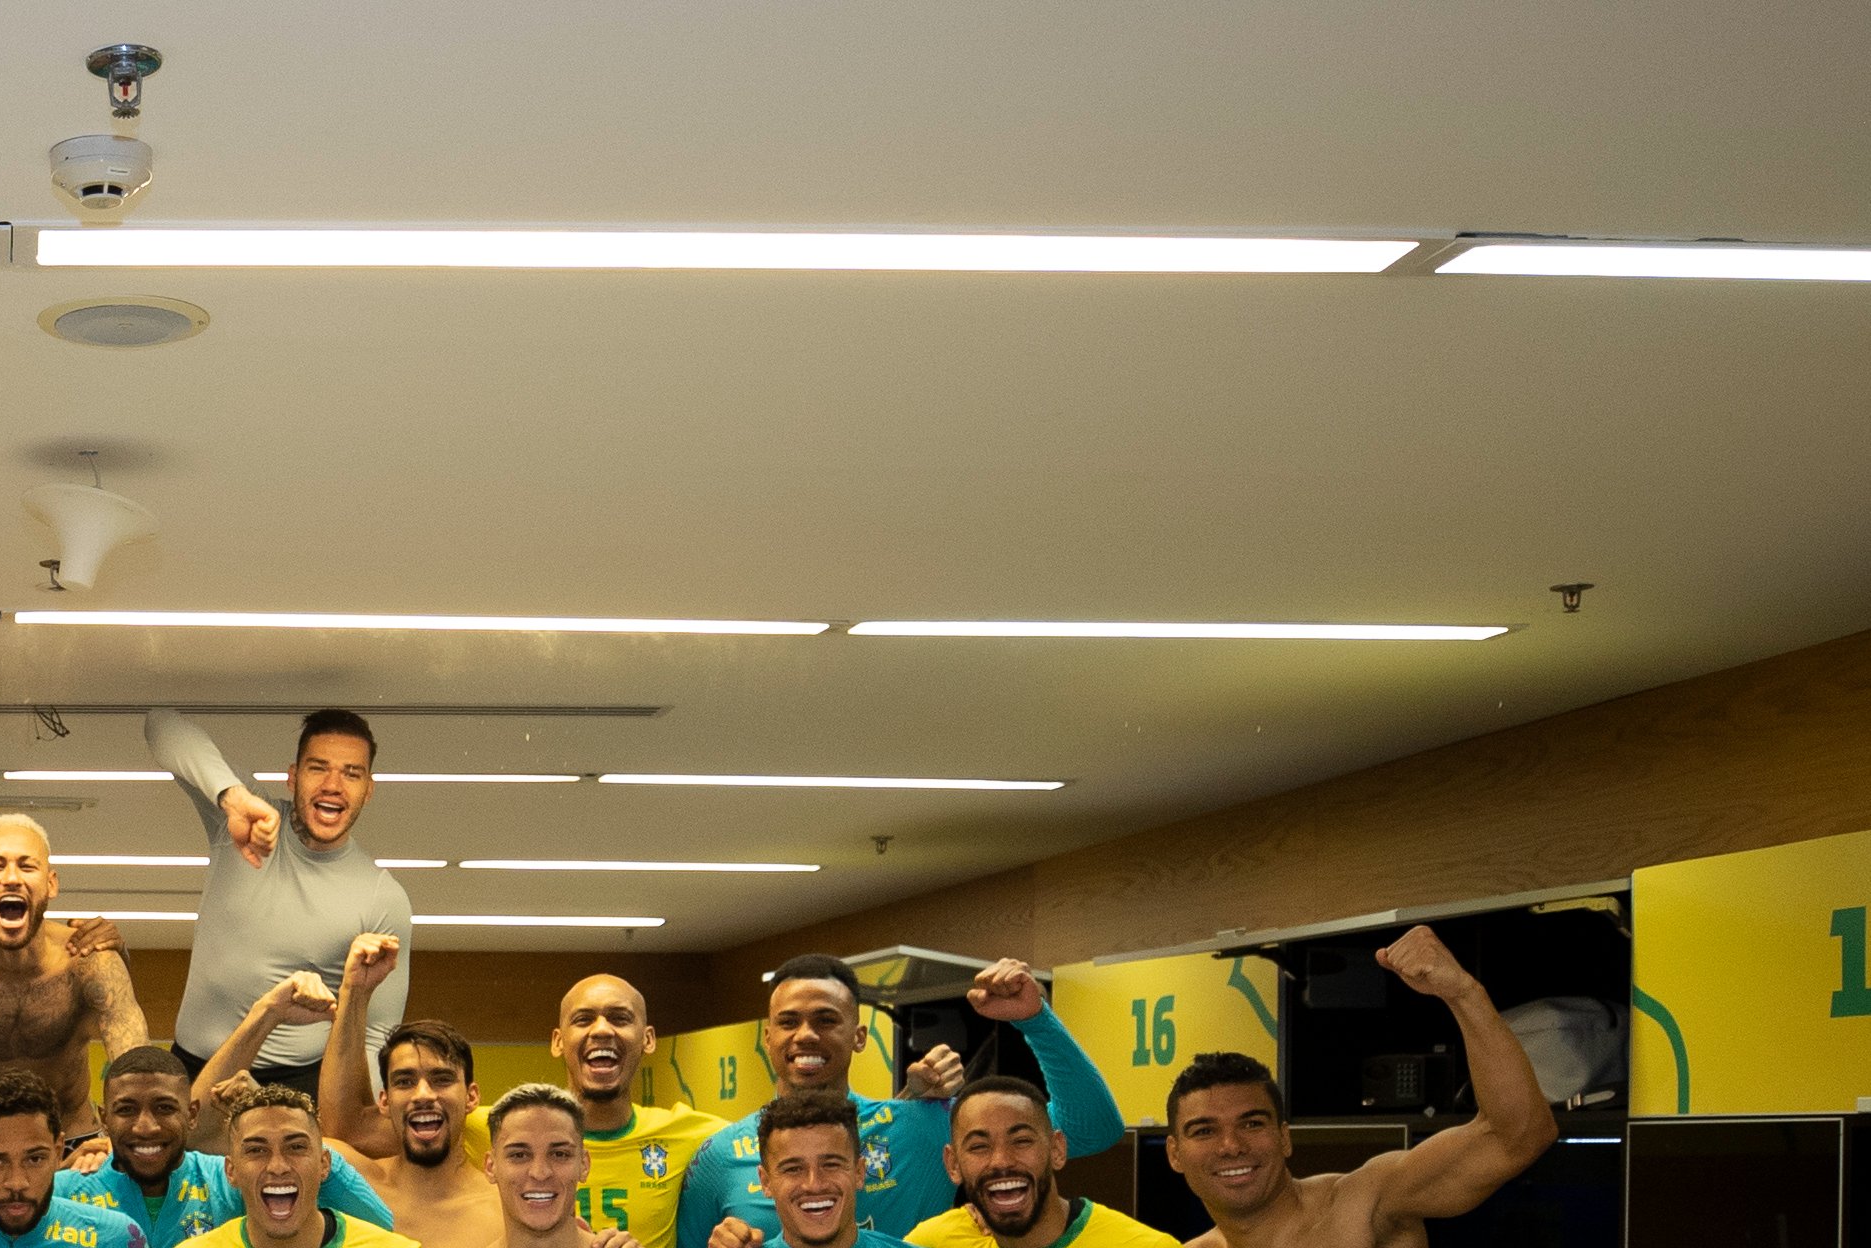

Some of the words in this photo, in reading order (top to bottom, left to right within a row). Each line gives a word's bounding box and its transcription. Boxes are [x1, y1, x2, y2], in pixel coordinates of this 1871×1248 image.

[1132, 995, 1176, 1068] 16
[719, 1055, 737, 1100] 13
[732, 1135, 761, 1159] It
[575, 1187, 629, 1232] 15
[44, 1220, 98, 1248] Itaú
